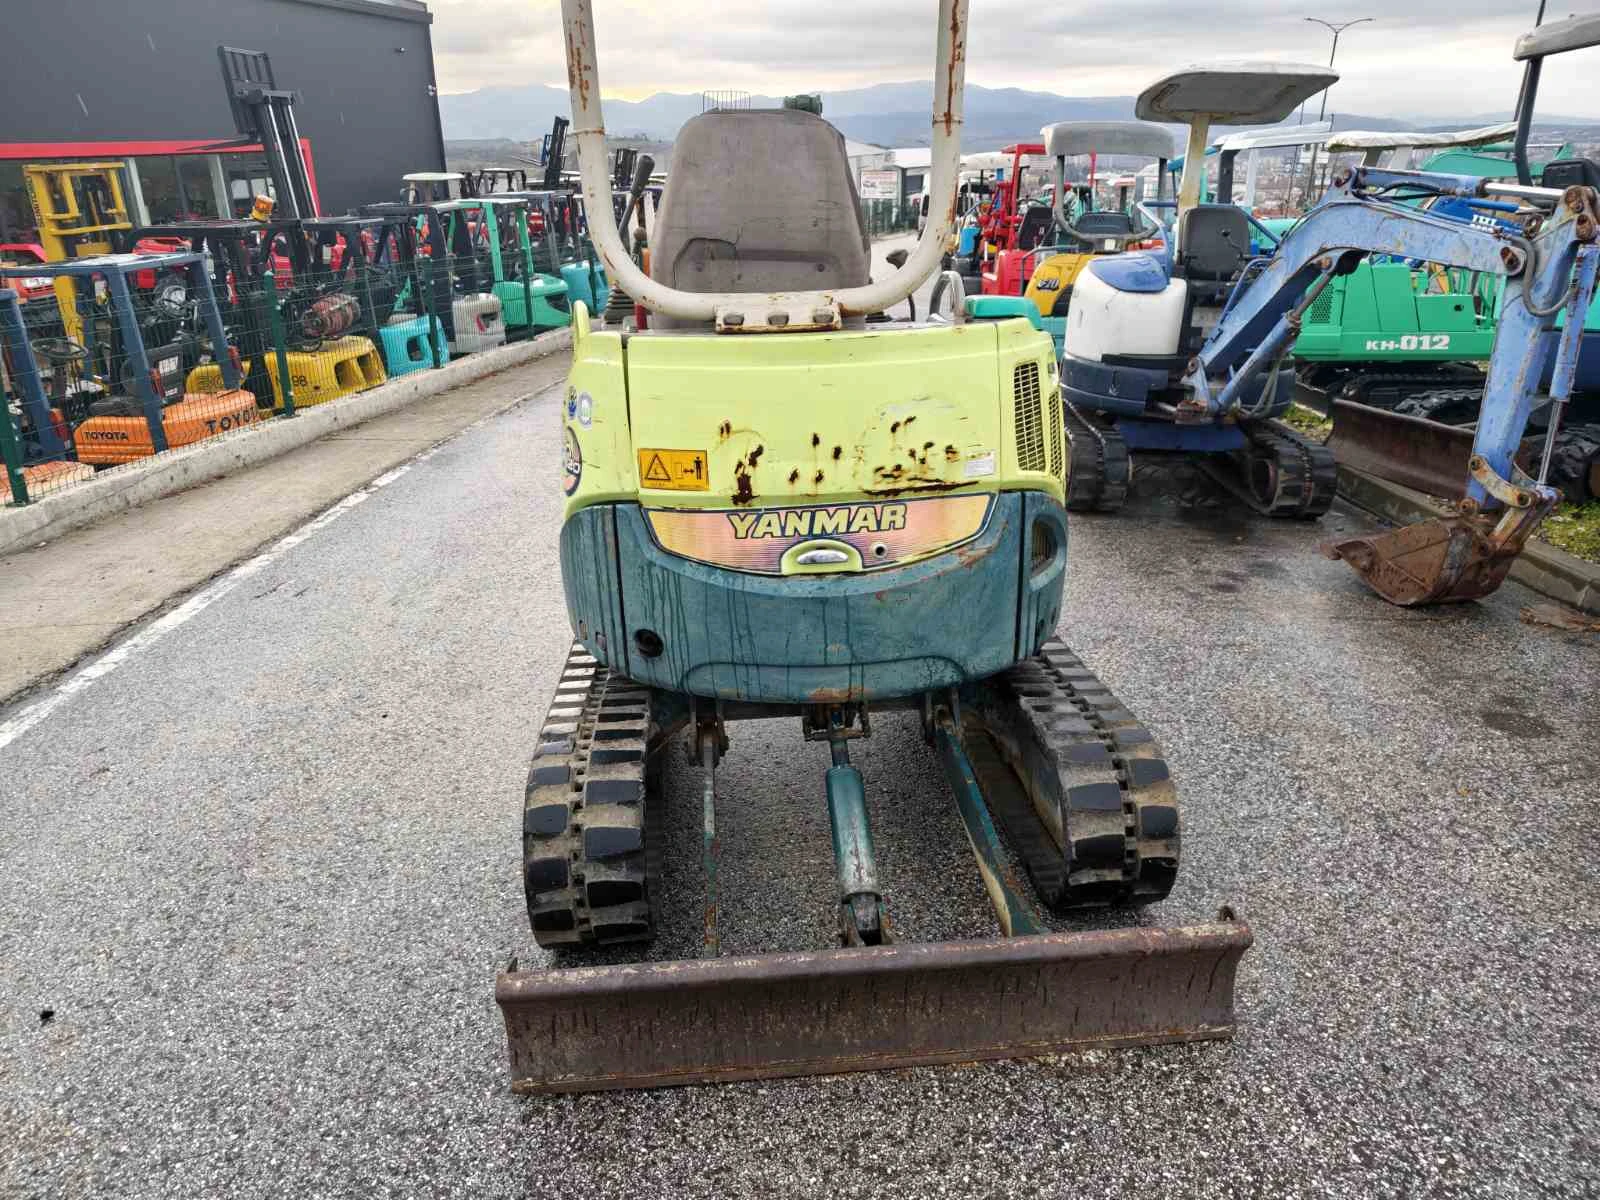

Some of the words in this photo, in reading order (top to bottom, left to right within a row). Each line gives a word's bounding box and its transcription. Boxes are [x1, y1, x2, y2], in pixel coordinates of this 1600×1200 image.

[1366, 335, 1450, 350] KH-012
[84, 431, 128, 441] TOYOTA
[727, 503, 907, 539] YANMAR
